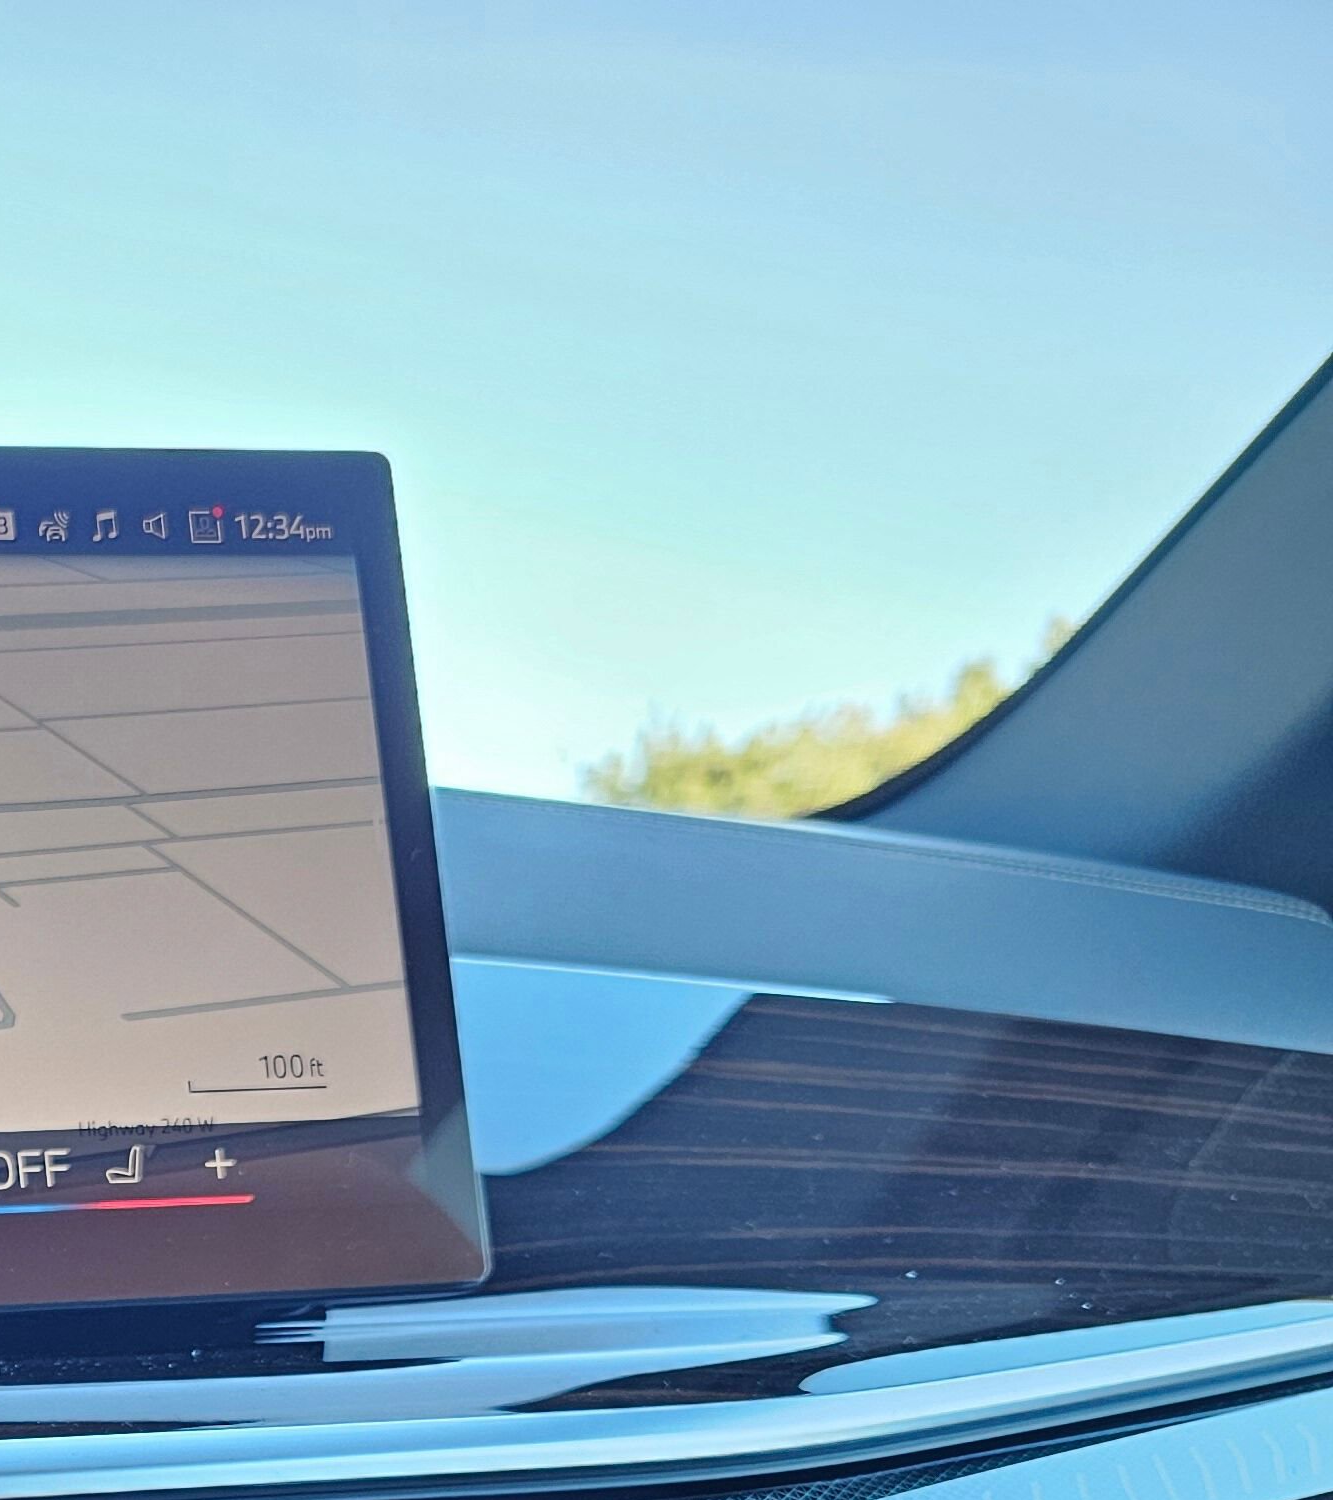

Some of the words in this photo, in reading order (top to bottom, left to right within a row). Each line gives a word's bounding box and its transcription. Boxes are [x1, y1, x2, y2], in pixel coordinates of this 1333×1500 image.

[234, 512, 334, 543] 12:34pm
[258, 1054, 304, 1079] 100
[309, 1057, 325, 1078] ft
[78, 1120, 155, 1142] Highway
[197, 1116, 214, 1133] W
